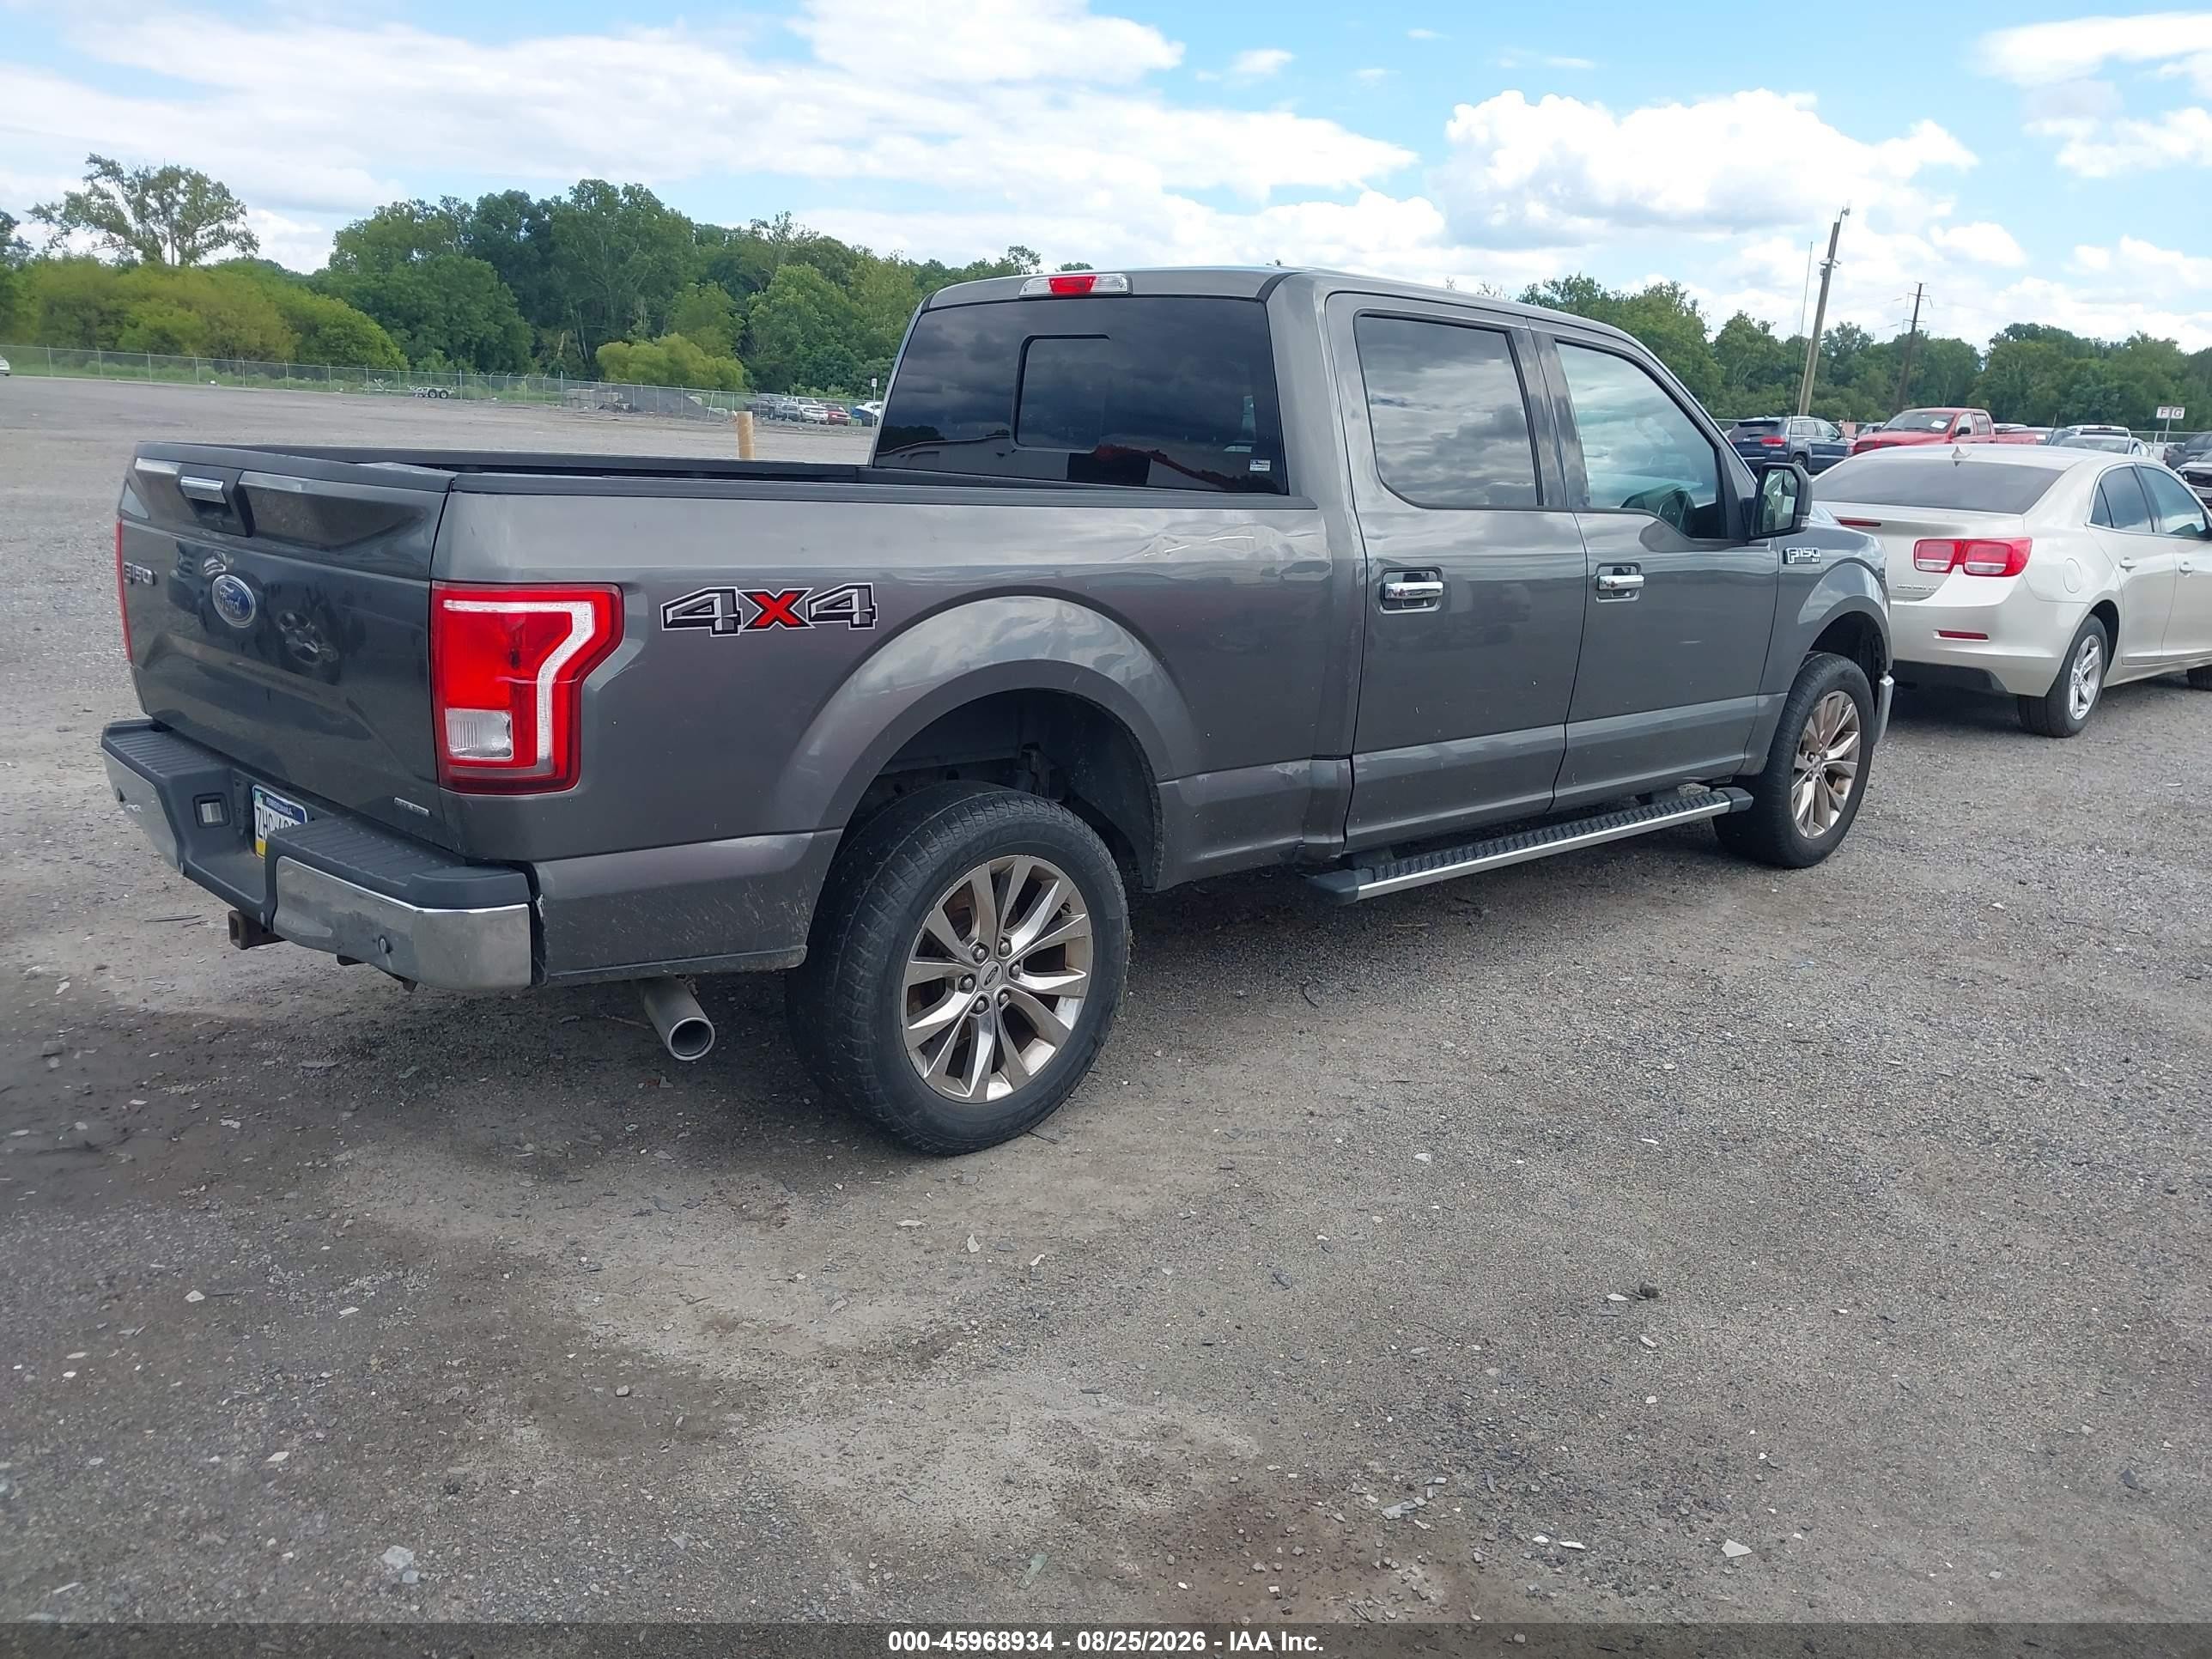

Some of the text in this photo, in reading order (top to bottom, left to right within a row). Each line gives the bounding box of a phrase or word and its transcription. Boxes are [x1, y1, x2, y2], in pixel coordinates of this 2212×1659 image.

[2160, 408, 2183, 417] F G
[218, 585, 242, 616] Ford
